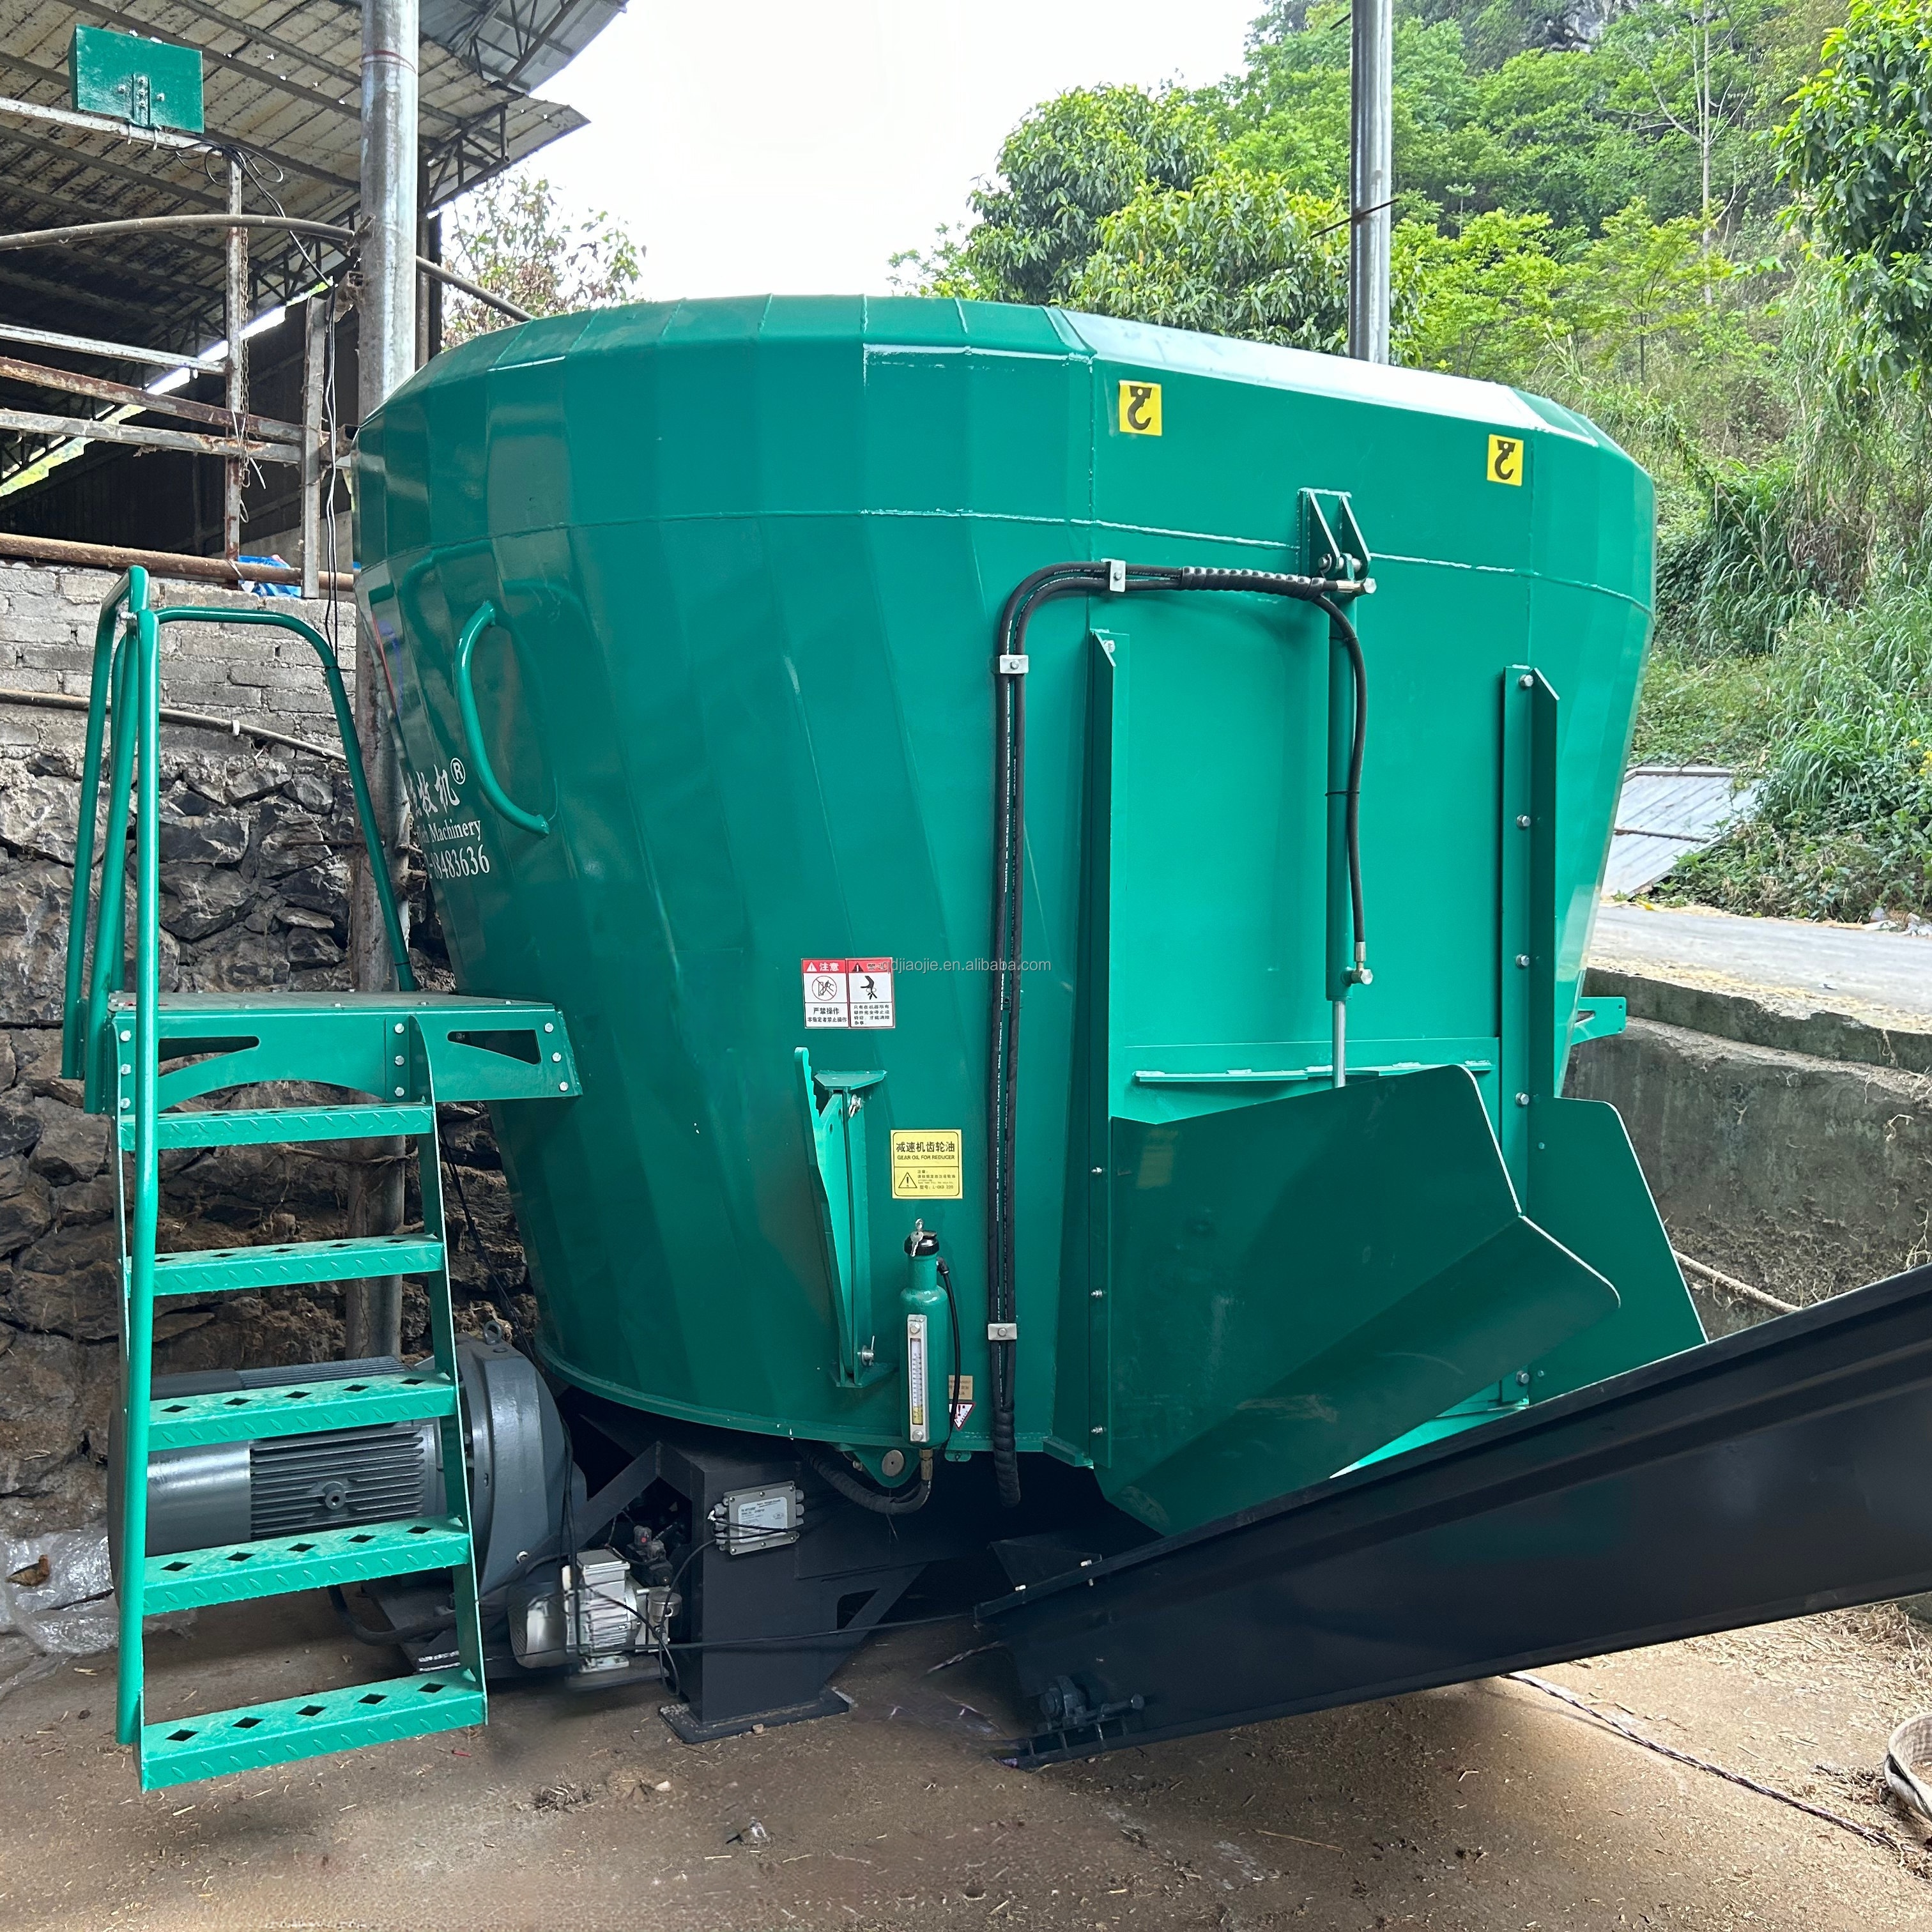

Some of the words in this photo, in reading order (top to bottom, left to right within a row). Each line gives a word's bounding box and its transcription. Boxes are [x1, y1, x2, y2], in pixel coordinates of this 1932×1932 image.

[428, 818, 481, 842] Machinery
[819, 962, 839, 972] 注意
[813, 1007, 839, 1015] 严禁操作
[896, 1140, 955, 1153] 减速机齿轮油
